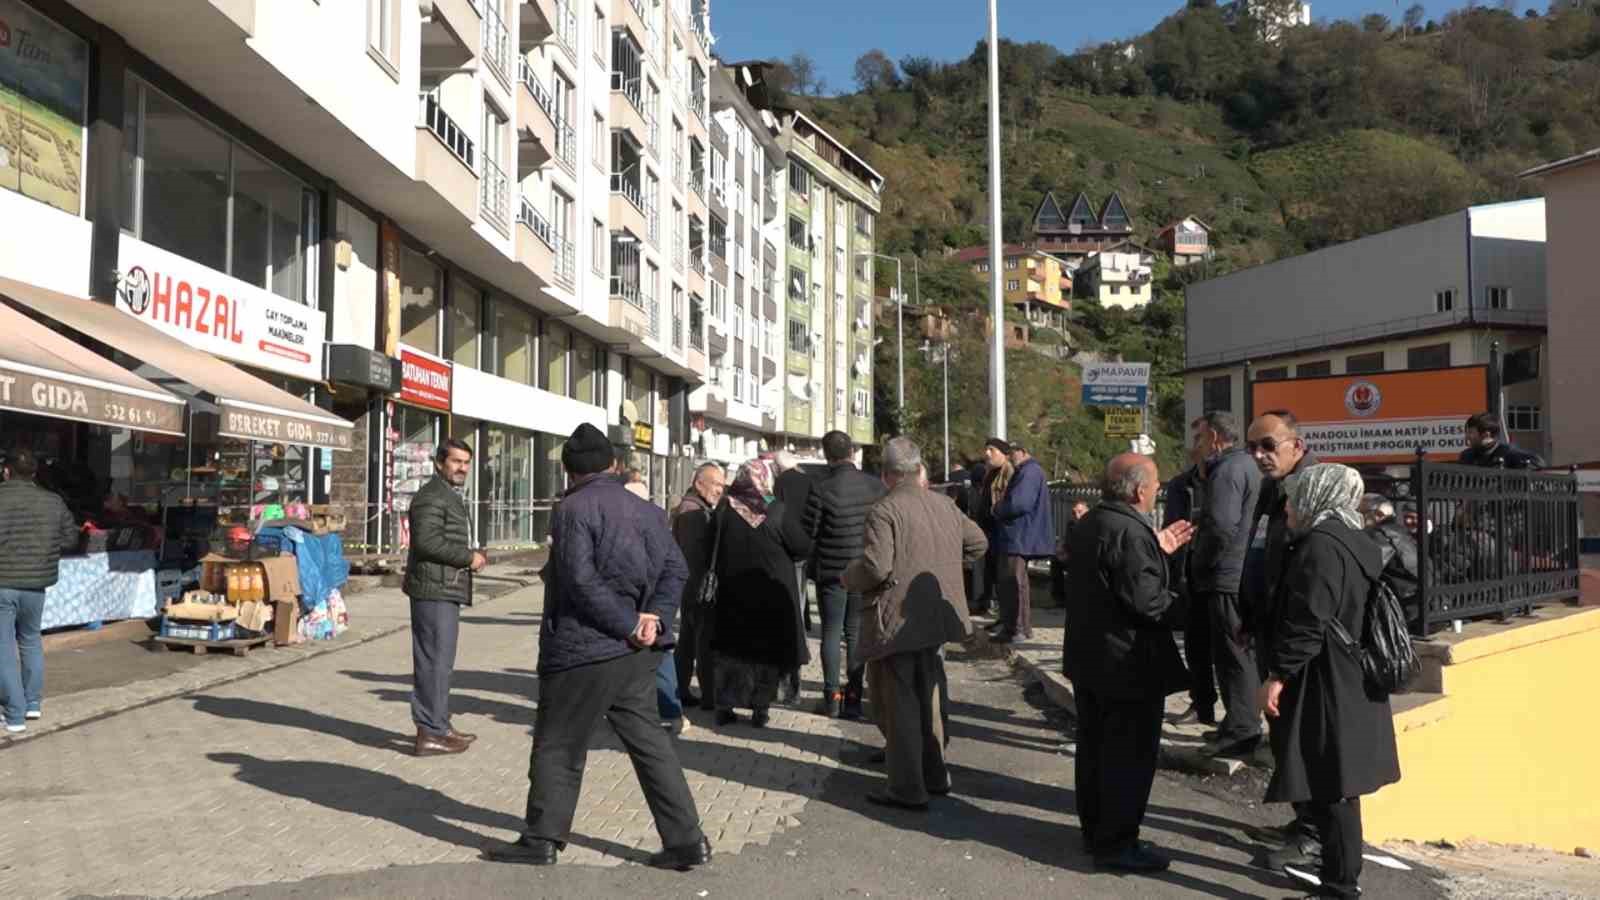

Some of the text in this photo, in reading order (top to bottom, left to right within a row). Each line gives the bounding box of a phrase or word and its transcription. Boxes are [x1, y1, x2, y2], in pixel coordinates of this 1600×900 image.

[152, 271, 244, 344] HAZAL
[31, 381, 88, 414] GIDA
[228, 412, 280, 437] BEREKET
[287, 421, 313, 441] GIDA
[1304, 430, 1358, 440] ANADOLU
[1360, 427, 1392, 438] İMAM
[1395, 425, 1429, 436] HATİP
[1373, 439, 1435, 449] PROGRAMI
